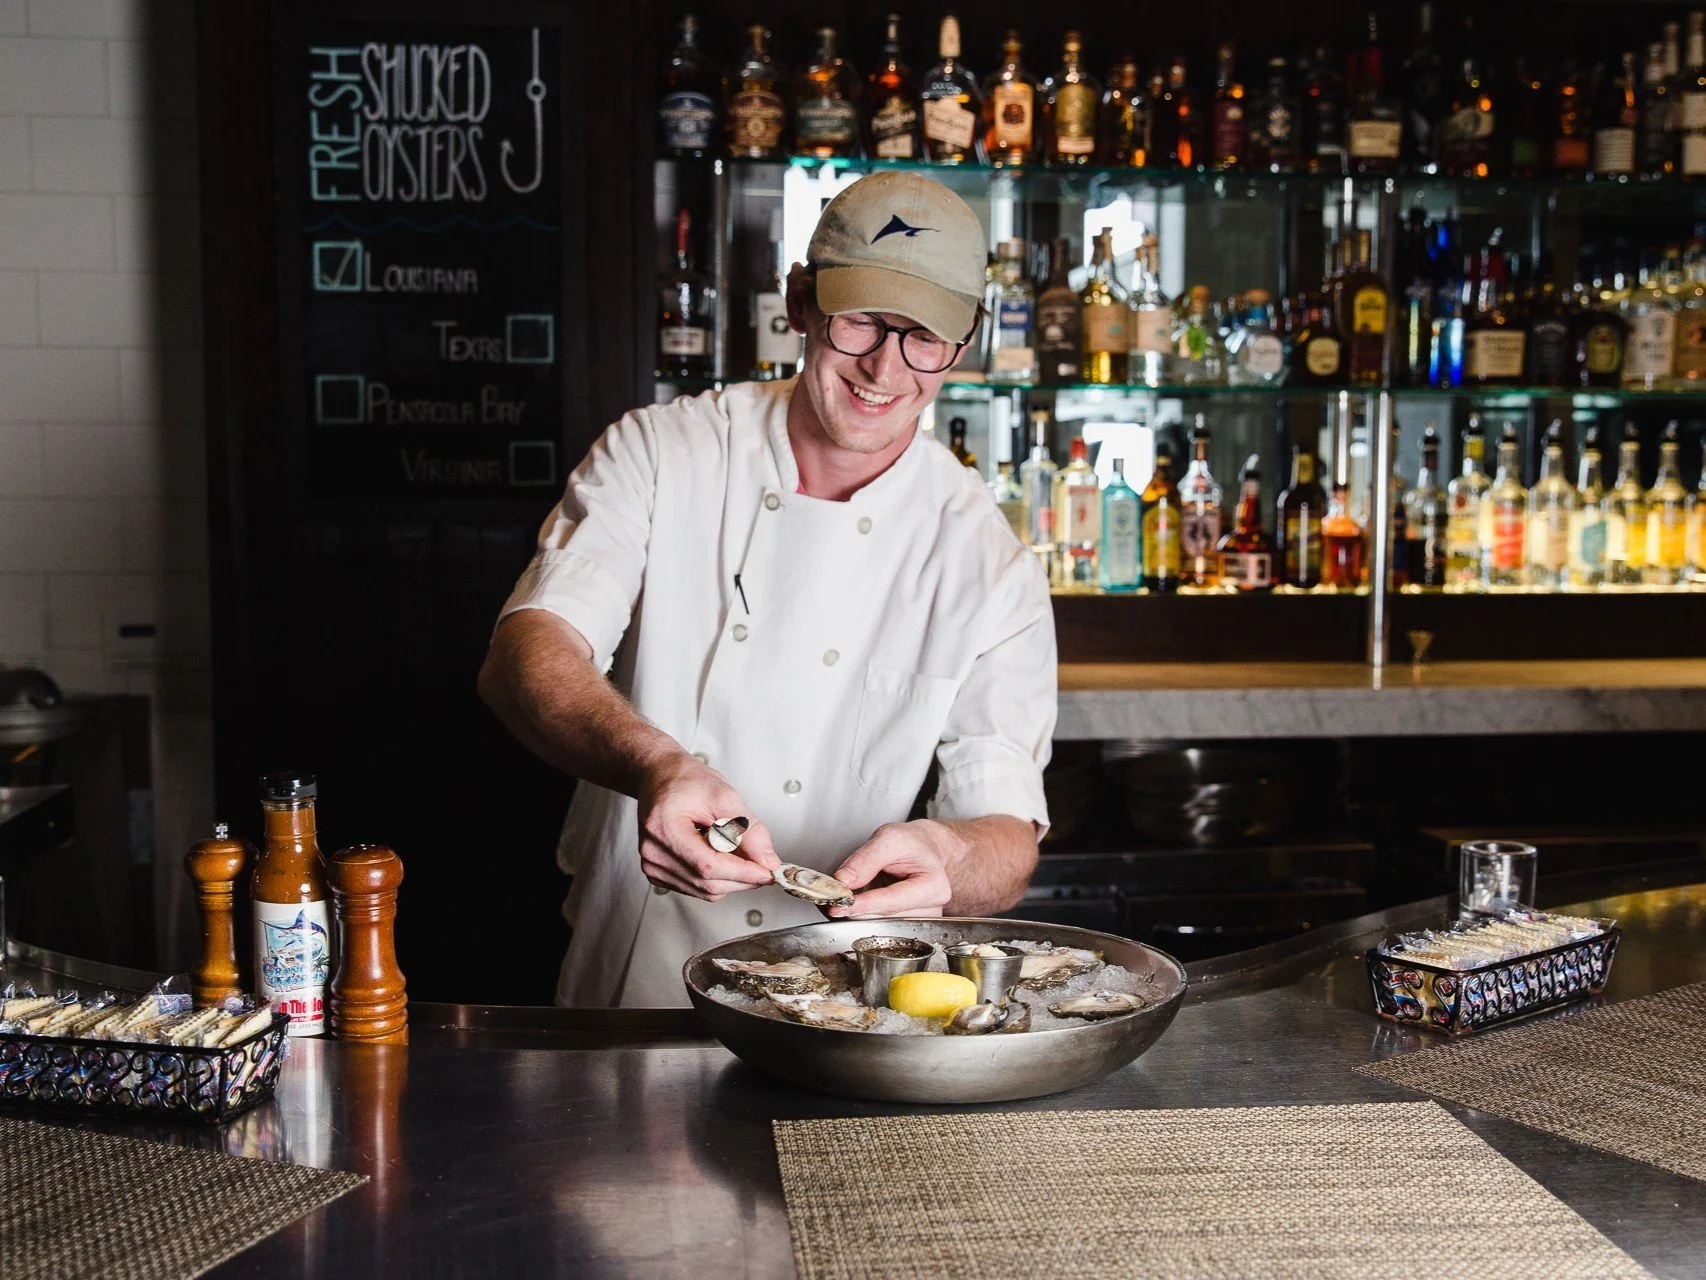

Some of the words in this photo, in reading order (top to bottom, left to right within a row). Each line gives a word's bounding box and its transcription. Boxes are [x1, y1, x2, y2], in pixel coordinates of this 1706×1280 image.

[361, 42, 492, 122] SHUCKED
[308, 46, 363, 202] FRESH
[362, 124, 488, 202] OYSTERS
[289, 999, 306, 1014] The
[1389, 973, 1416, 983] Lace
